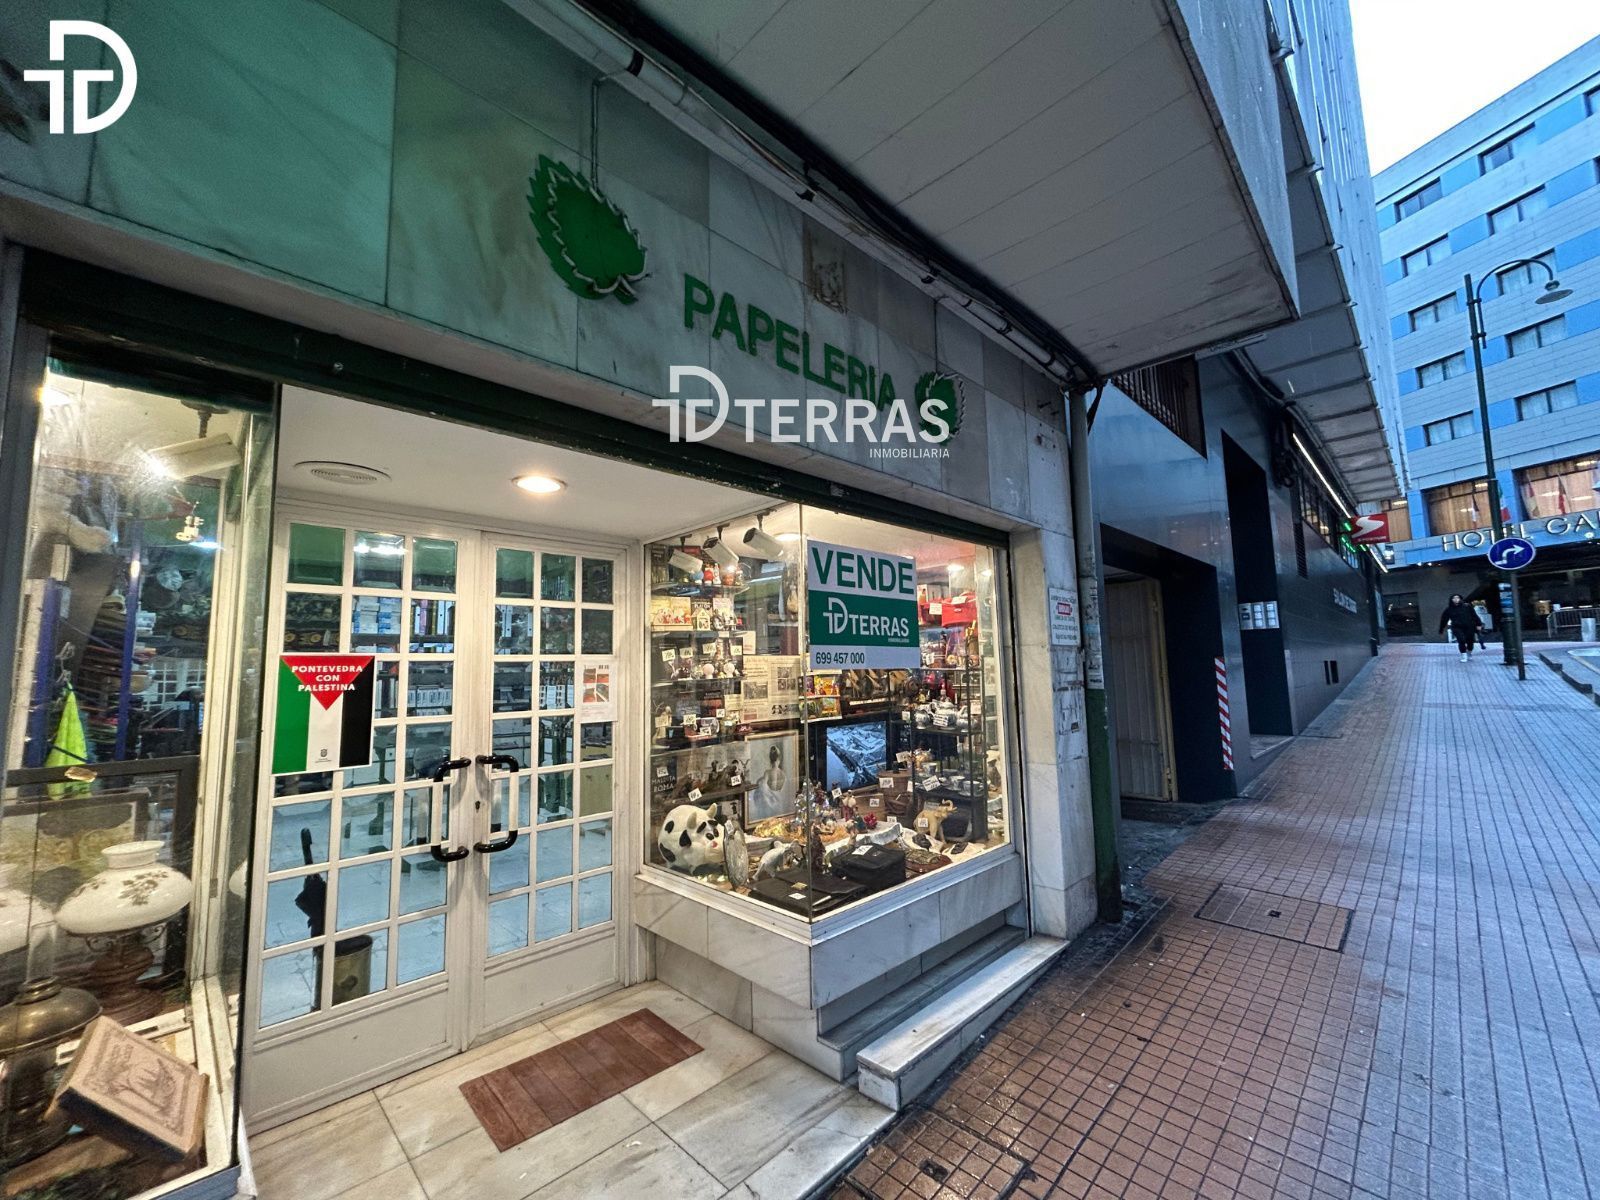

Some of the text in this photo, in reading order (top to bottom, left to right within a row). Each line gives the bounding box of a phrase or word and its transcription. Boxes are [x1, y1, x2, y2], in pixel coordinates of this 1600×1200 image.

[684, 272, 896, 411] PAPELERIA
[1545, 511, 1600, 535] GA
[811, 547, 915, 595] VENDE
[848, 613, 910, 637] TERRAS
[815, 652, 865, 665] 699 457 000
[291, 665, 363, 673] PONTEVEDRA
[315, 674, 340, 682] CON
[297, 683, 356, 692] PALESTINA
